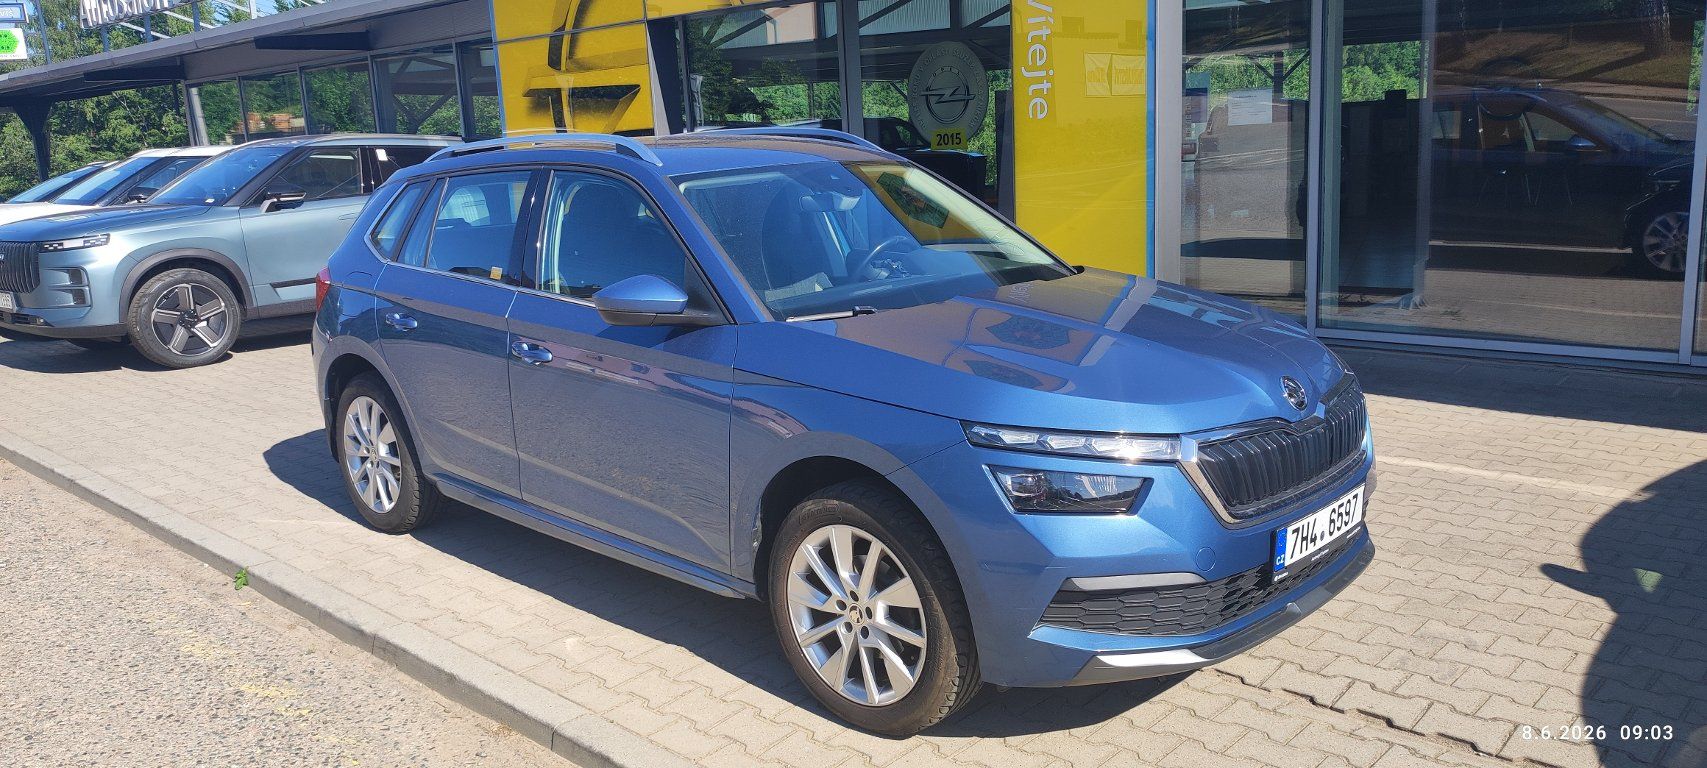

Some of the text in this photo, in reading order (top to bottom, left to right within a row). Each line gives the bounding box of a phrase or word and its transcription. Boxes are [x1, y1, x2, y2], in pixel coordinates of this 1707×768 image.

[1021, 0, 1055, 120] Vítejte
[936, 132, 962, 147] 2015
[1290, 493, 1359, 559] 7H4 6597
[1276, 553, 1285, 566] CZ
